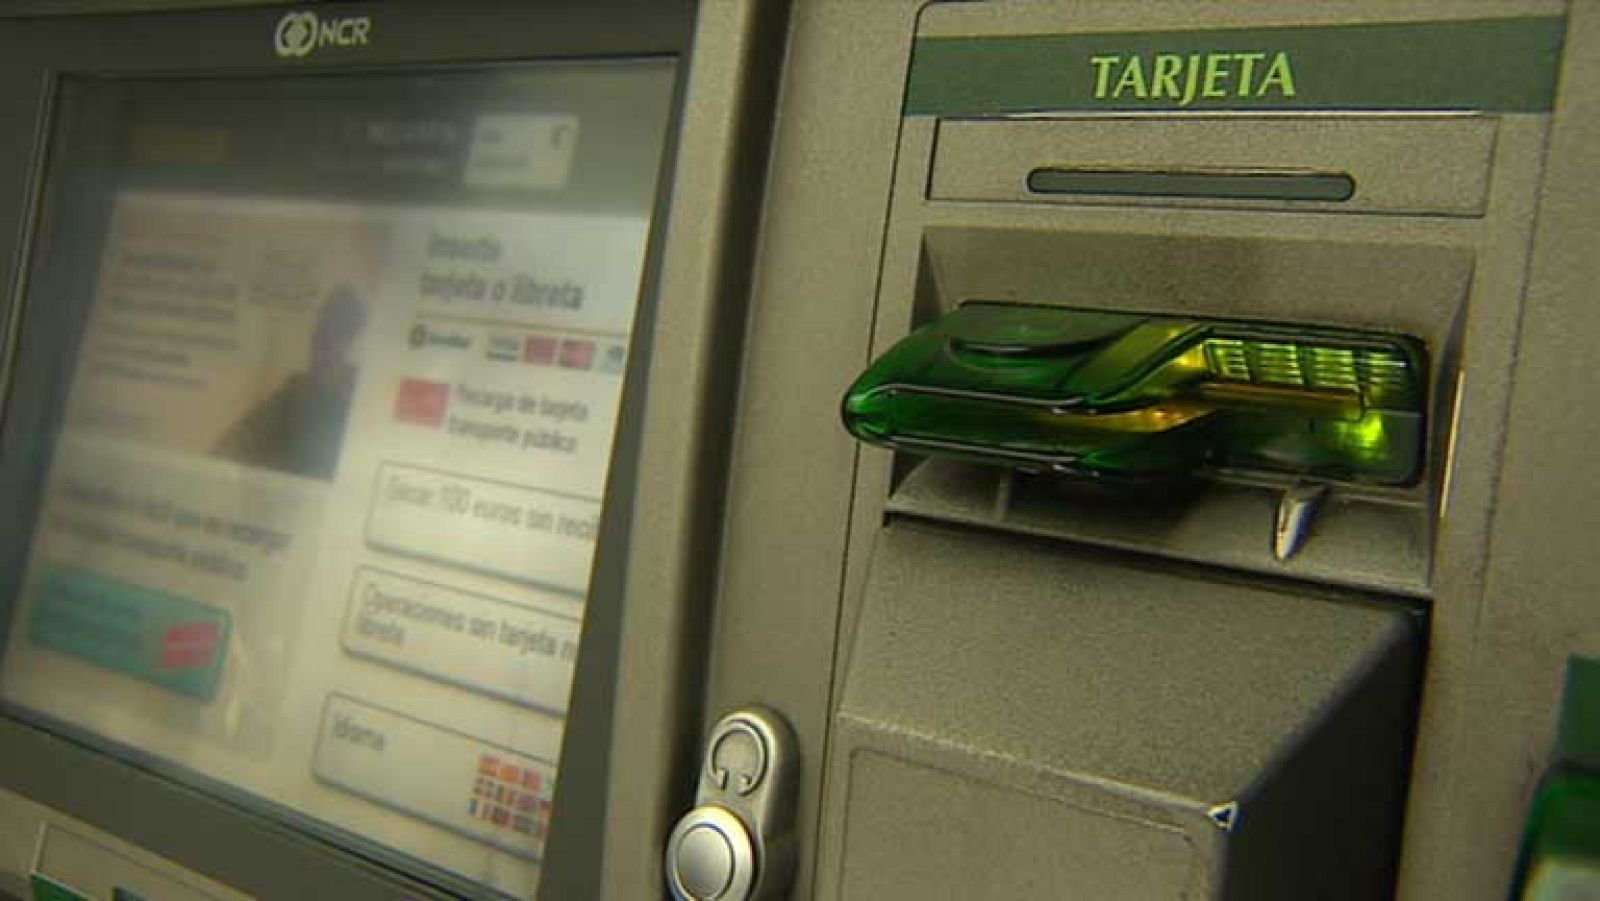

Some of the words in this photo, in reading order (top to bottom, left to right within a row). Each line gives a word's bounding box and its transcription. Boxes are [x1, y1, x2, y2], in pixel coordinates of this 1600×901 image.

[319, 17, 369, 48] NCR
[1090, 52, 1296, 107] TARJETA
[491, 280, 507, 302] o
[510, 272, 584, 311] libreta
